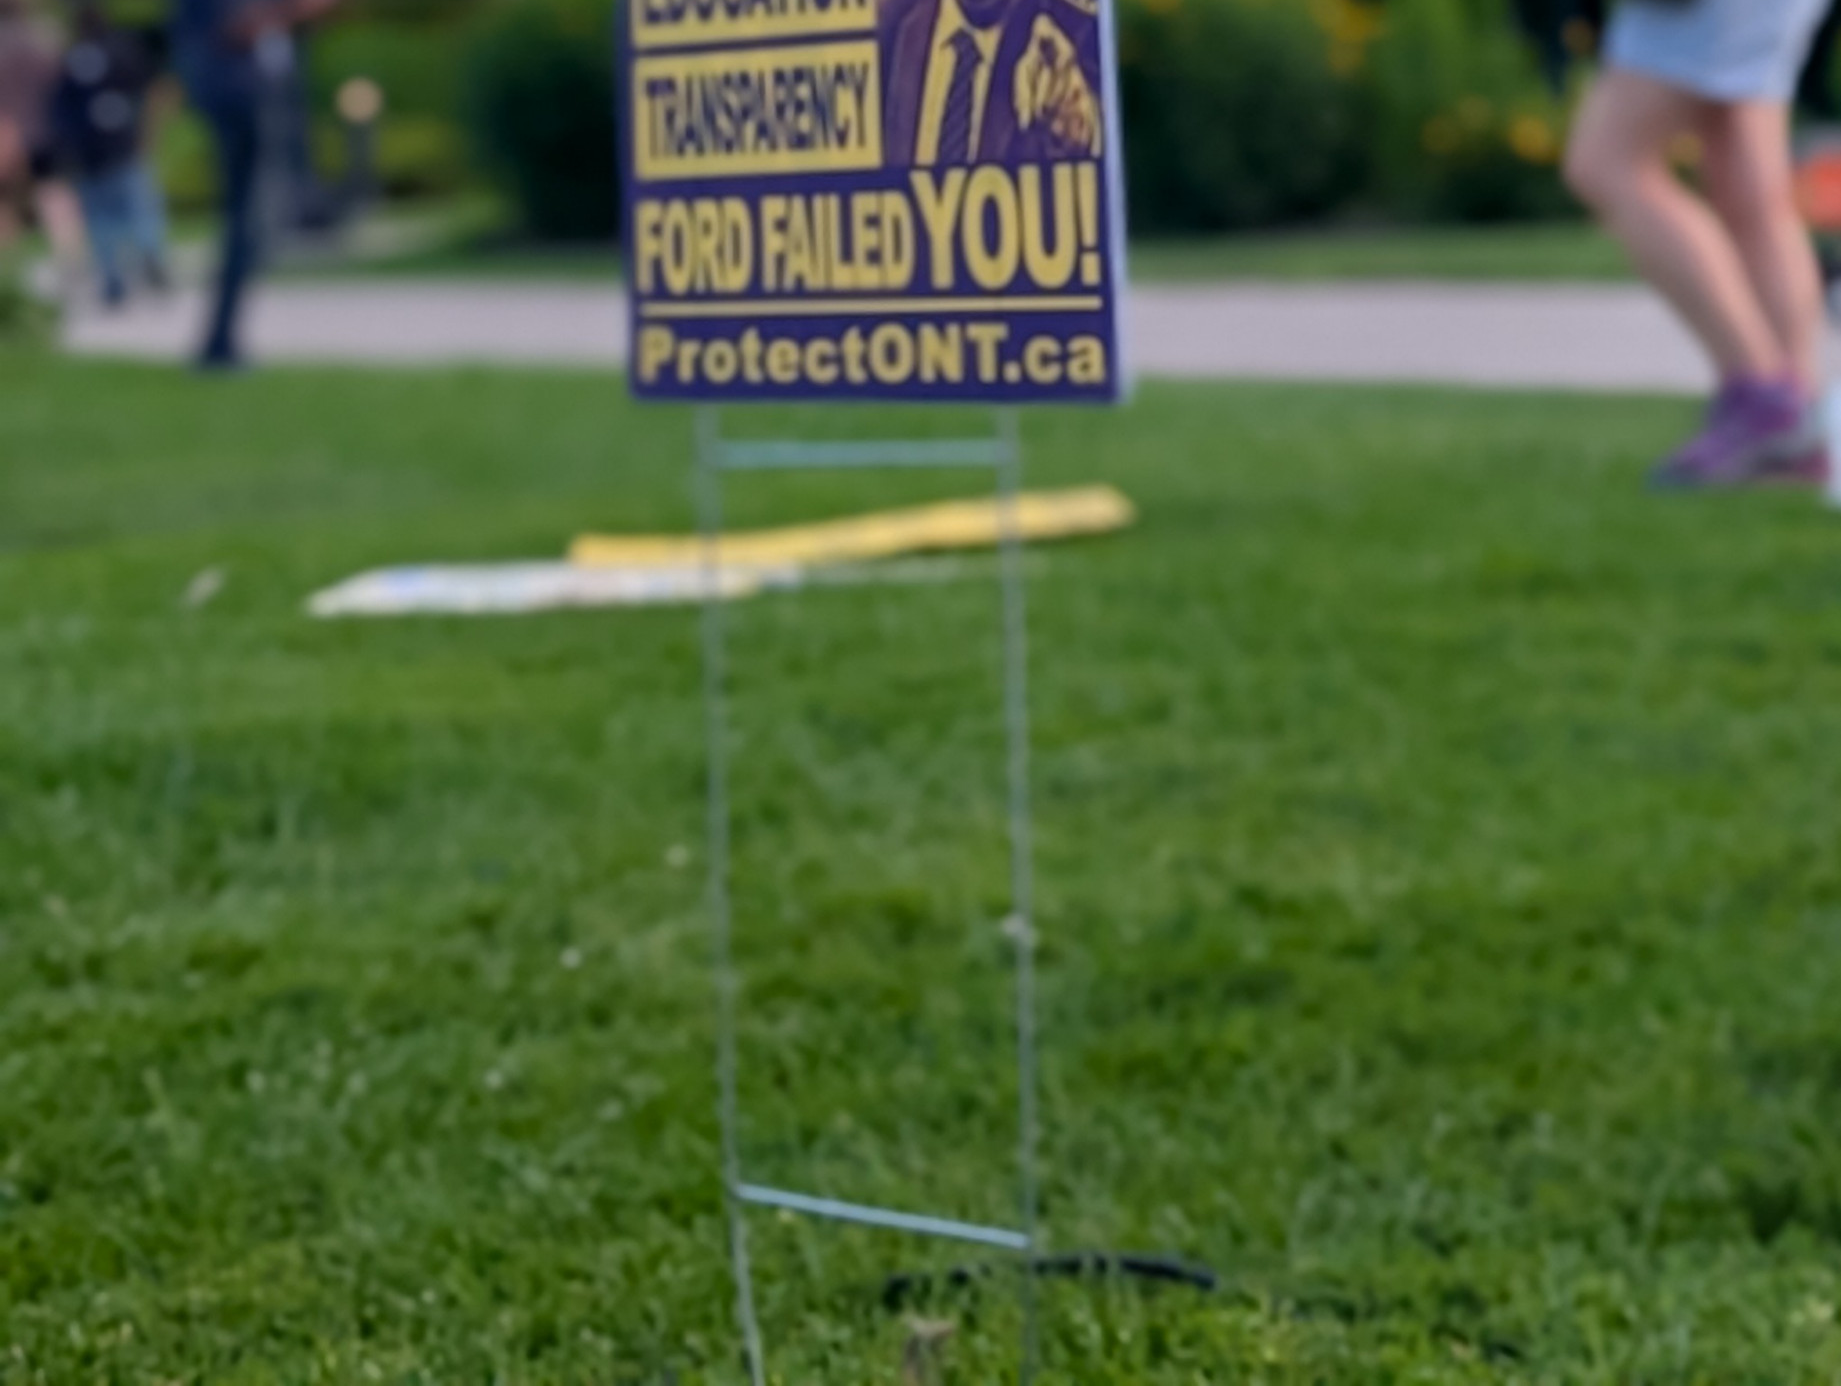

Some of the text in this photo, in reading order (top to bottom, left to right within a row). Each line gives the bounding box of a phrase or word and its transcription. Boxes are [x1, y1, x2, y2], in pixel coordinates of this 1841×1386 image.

[645, 60, 870, 160] TRANSPARENCY
[636, 160, 1102, 294] FORD FAILED YOU!
[638, 323, 1107, 385] ProtectONT.ca
